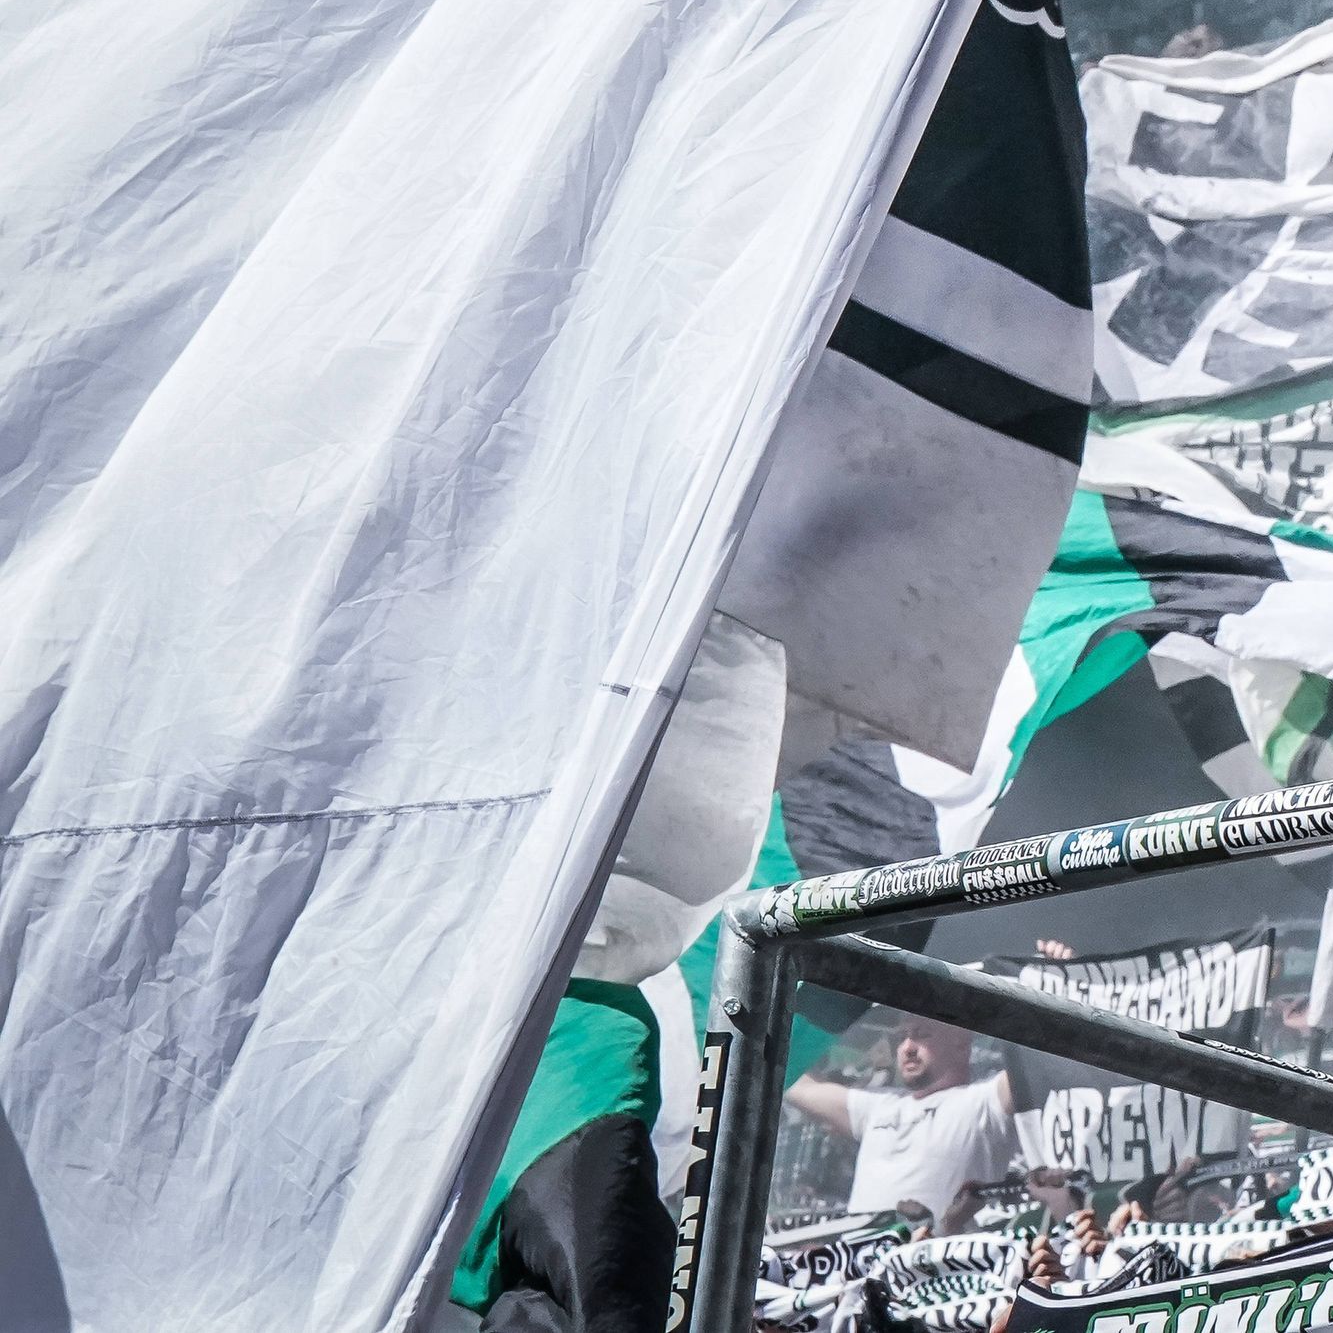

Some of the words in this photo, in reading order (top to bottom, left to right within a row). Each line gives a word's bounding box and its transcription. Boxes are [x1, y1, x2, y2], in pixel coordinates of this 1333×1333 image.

[963, 836, 1051, 869] MODERNEN
[1129, 816, 1218, 860] KURVE
[1041, 1080, 1203, 1184] CREW
